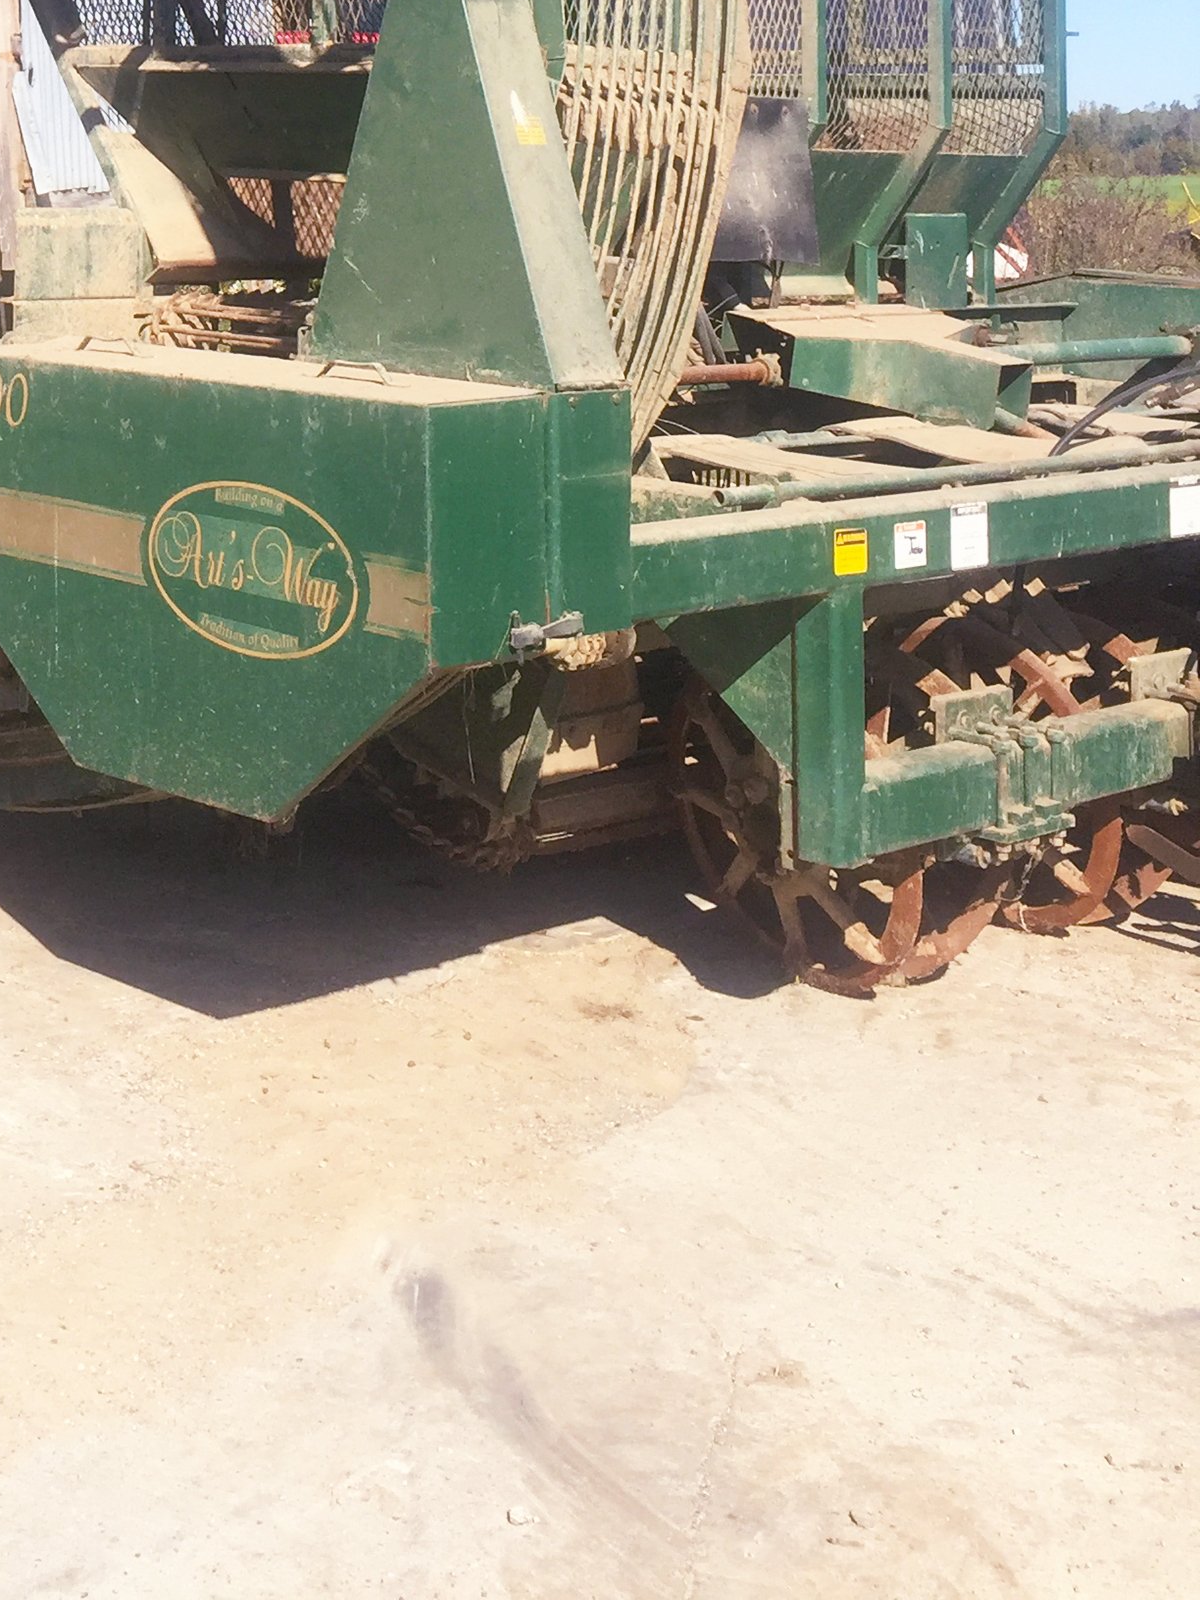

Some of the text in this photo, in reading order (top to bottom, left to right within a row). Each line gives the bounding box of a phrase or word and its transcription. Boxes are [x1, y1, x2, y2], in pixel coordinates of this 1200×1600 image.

[200, 612, 300, 651] Tradition of Quality
